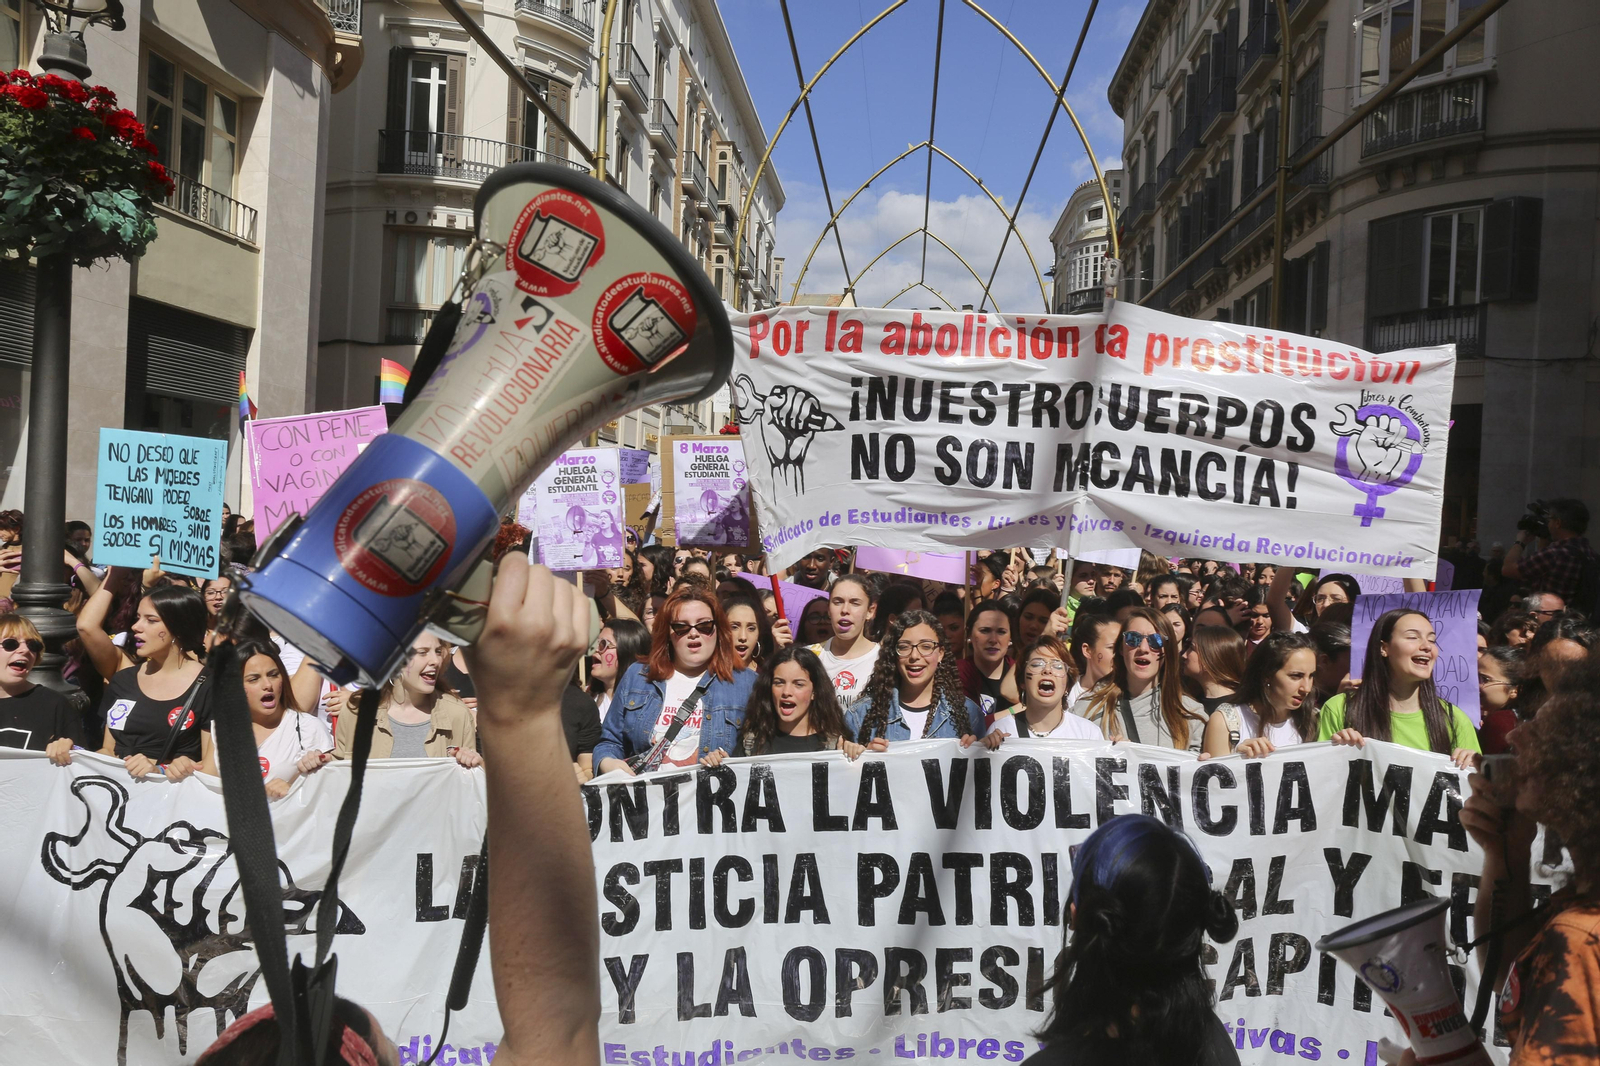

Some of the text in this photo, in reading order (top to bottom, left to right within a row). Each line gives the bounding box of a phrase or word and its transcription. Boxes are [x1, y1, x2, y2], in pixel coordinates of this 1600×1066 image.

[748, 312, 809, 360] Por
[824, 310, 865, 354] la
[879, 312, 1080, 361] abolición
[1142, 330, 1421, 386] prostitución
[450, 318, 580, 468] REVOLUCIONARIA
[260, 414, 370, 451] CON PENE
[108, 442, 200, 465] NO DESEO QUE
[290, 445, 346, 467] O CON
[556, 454, 596, 466] Marzo
[680, 442, 729, 454] 8 Marzo
[694, 455, 729, 463] HUELGA
[558, 466, 597, 475] HUELGA
[690, 463, 730, 471] GENERAL
[850, 432, 917, 482] NO
[934, 435, 1035, 490] SON
[128, 465, 201, 486] LAS MUJERES
[264, 466, 341, 493] VAGIN
[554, 475, 598, 485] GENERAL
[684, 471, 730, 479] ESTUDIANTIL
[104, 483, 190, 505] TENGAN PODER
[548, 484, 599, 494] ESTUDIANTIL
[183, 505, 211, 522] SOBRE
[103, 513, 124, 529] LOS
[187, 523, 210, 541] SINO
[763, 518, 814, 553] Sindicato
[819, 511, 841, 527] de
[848, 507, 971, 529] Estudiantes
[1055, 515, 1066, 531] y
[1144, 523, 1251, 553] Izquierda
[1256, 537, 1415, 569] Revolucionaria
[103, 531, 141, 548] SOBRE
[169, 538, 215, 568] MISMAS
[1361, 594, 1387, 623] NO
[580, 762, 786, 843] ONTRA
[812, 760, 898, 832] LA
[921, 754, 1318, 837] VIOLENCIA
[601, 853, 831, 937] STICIA
[1323, 847, 1372, 919] Y
[603, 953, 650, 1024] Y
[676, 946, 757, 1022] LA
[781, 945, 1046, 1023] OPRESI
[603, 1037, 832, 1066] Estudiantes
[894, 1030, 1025, 1062] Libres
